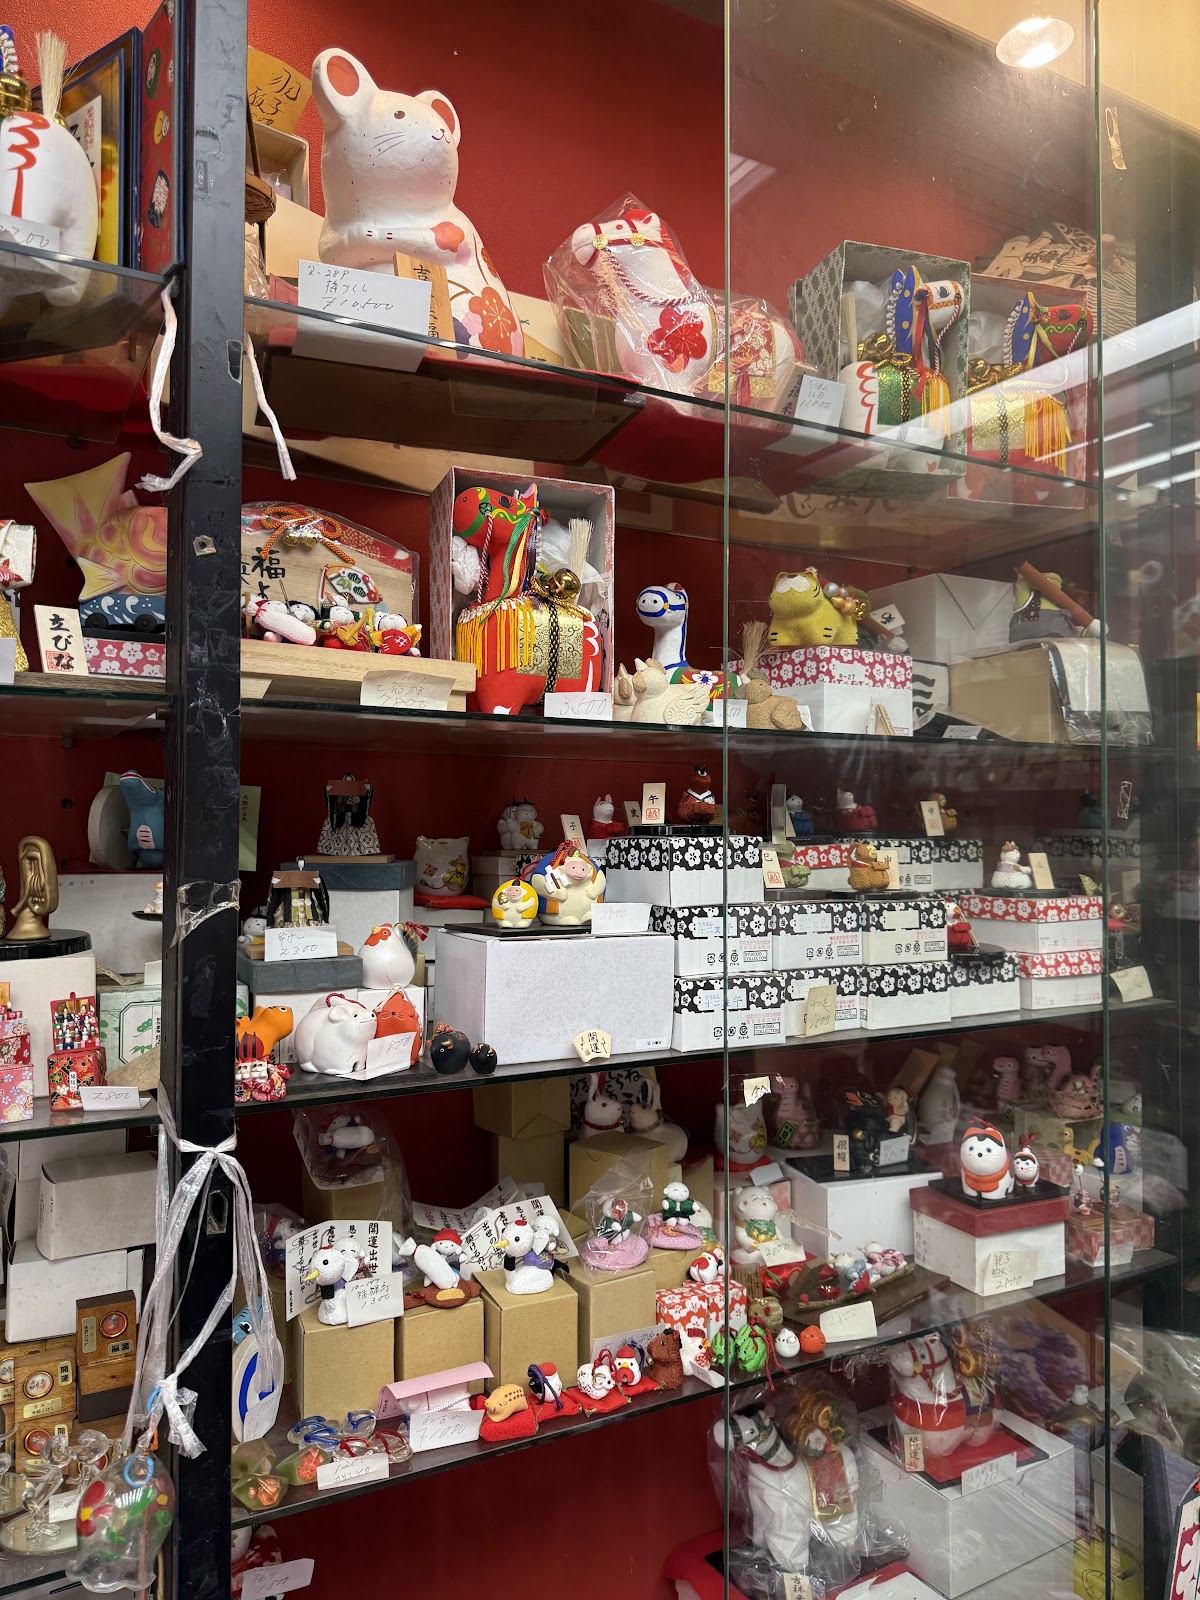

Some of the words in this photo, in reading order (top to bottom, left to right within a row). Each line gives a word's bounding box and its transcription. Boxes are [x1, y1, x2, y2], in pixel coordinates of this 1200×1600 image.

[49, 613, 75, 670] 立びな
[559, 697, 607, 716] 3500
[648, 795, 659, 805] 午
[280, 944, 318, 956] 2300
[368, 1222, 379, 1274] 開運出世
